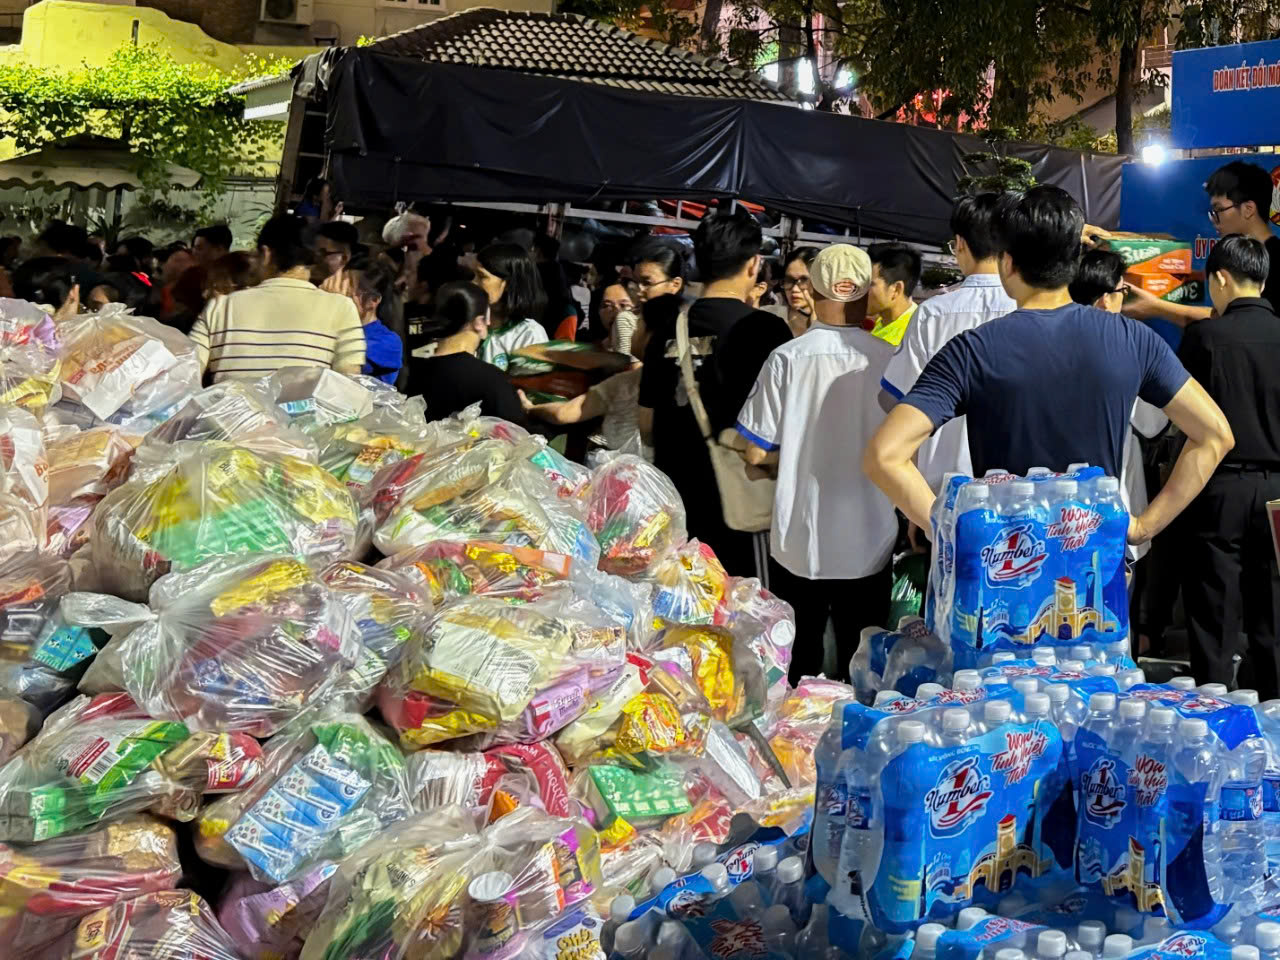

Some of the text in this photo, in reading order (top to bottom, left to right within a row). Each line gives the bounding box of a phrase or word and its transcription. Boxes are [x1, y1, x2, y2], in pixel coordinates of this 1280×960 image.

[982, 541, 1042, 566] Number
[925, 775, 986, 812] Number
[1082, 775, 1120, 799] Number
